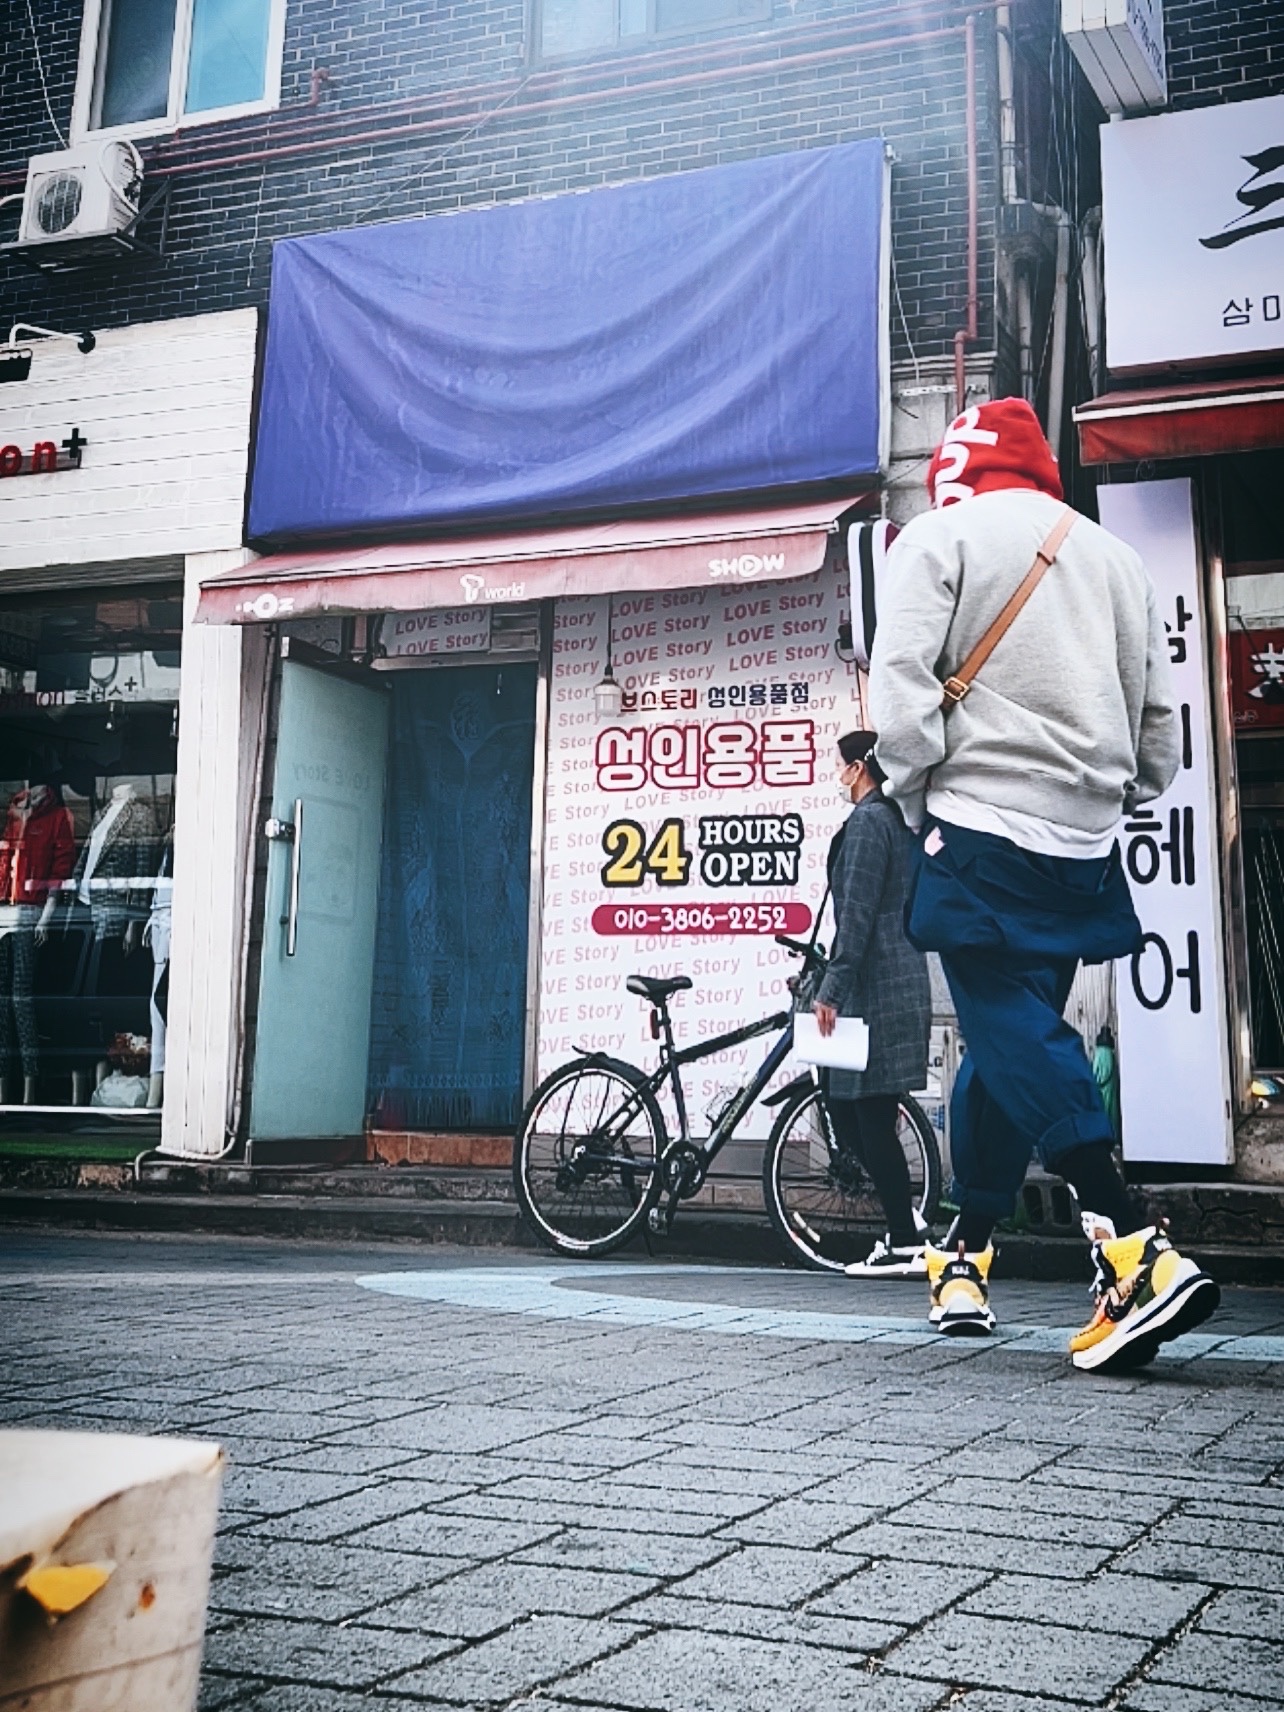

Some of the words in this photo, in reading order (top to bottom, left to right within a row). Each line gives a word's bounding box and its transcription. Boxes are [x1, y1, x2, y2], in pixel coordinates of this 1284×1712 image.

[708, 552, 785, 578] SHOW
[485, 582, 526, 599] world
[395, 615, 438, 635] LOVE
[443, 608, 488, 627] Story
[552, 636, 598, 653] Story
[611, 621, 658, 643] LOVE
[664, 614, 711, 633] Story
[724, 599, 771, 622] LOVE
[778, 592, 825, 611] Story
[553, 611, 596, 630] Story
[610, 596, 655, 619] LOVE
[661, 589, 709, 609] Story
[445, 632, 489, 650] Story
[554, 660, 600, 678] Story
[612, 646, 659, 668] LOVE
[666, 639, 713, 658] Story
[727, 625, 775, 647] LOVE
[782, 617, 828, 636] Story
[625, 671, 660, 691] OVE
[668, 664, 716, 683] Story
[729, 650, 777, 672] LOVE
[785, 643, 830, 662] Story
[708, 681, 809, 709] 성인용품점
[559, 736, 594, 749] Stor
[594, 718, 817, 793] 성인용품
[565, 803, 610, 821] Story
[624, 792, 672, 812] LOVE
[700, 816, 802, 847] HOURS
[602, 817, 694, 889] 24
[702, 849, 798, 884] OPEN
[570, 888, 616, 905] Story
[613, 903, 788, 933] 010-3806-2252
[573, 945, 620, 962] Story
[575, 974, 622, 991] Story
[692, 957, 741, 976] Story
[577, 1003, 624, 1021] Story
[694, 987, 744, 1006] Story
[579, 1032, 627, 1050] Story
[697, 1018, 747, 1036] Story
